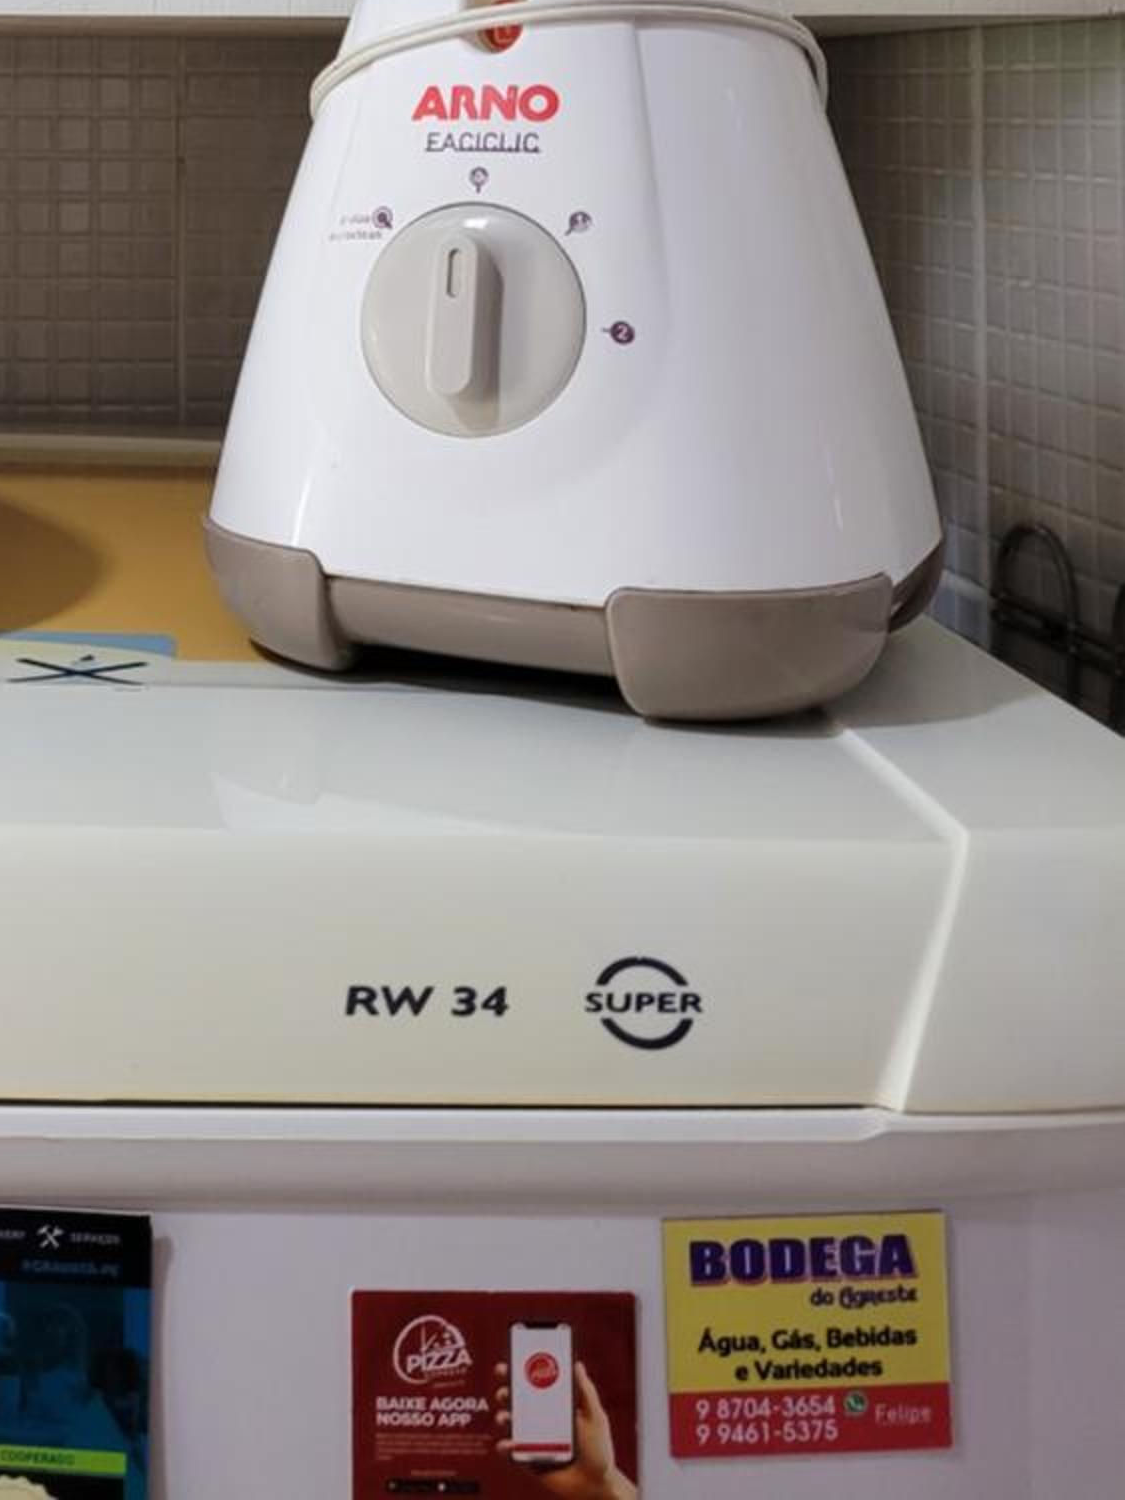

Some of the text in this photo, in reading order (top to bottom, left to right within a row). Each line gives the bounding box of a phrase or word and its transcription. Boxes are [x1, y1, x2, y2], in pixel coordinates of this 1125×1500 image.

[411, 84, 560, 122] ARNO
[345, 986, 510, 1017] RW 34
[584, 992, 703, 1014] SUPER
[689, 1234, 917, 1287] BODEGA
[809, 1288, 833, 1306] do
[698, 1327, 917, 1357] Água, Gás, Bebidas
[407, 1347, 473, 1373] PIZZA
[735, 1358, 883, 1381] e Variedades
[376, 1396, 489, 1412] BAIXE AGORA
[696, 1396, 836, 1419] 9 8704-3654
[875, 1403, 931, 1425] Felipe
[376, 1411, 472, 1427] NOSSO APP
[696, 1419, 838, 1444] 9 9461-5375
